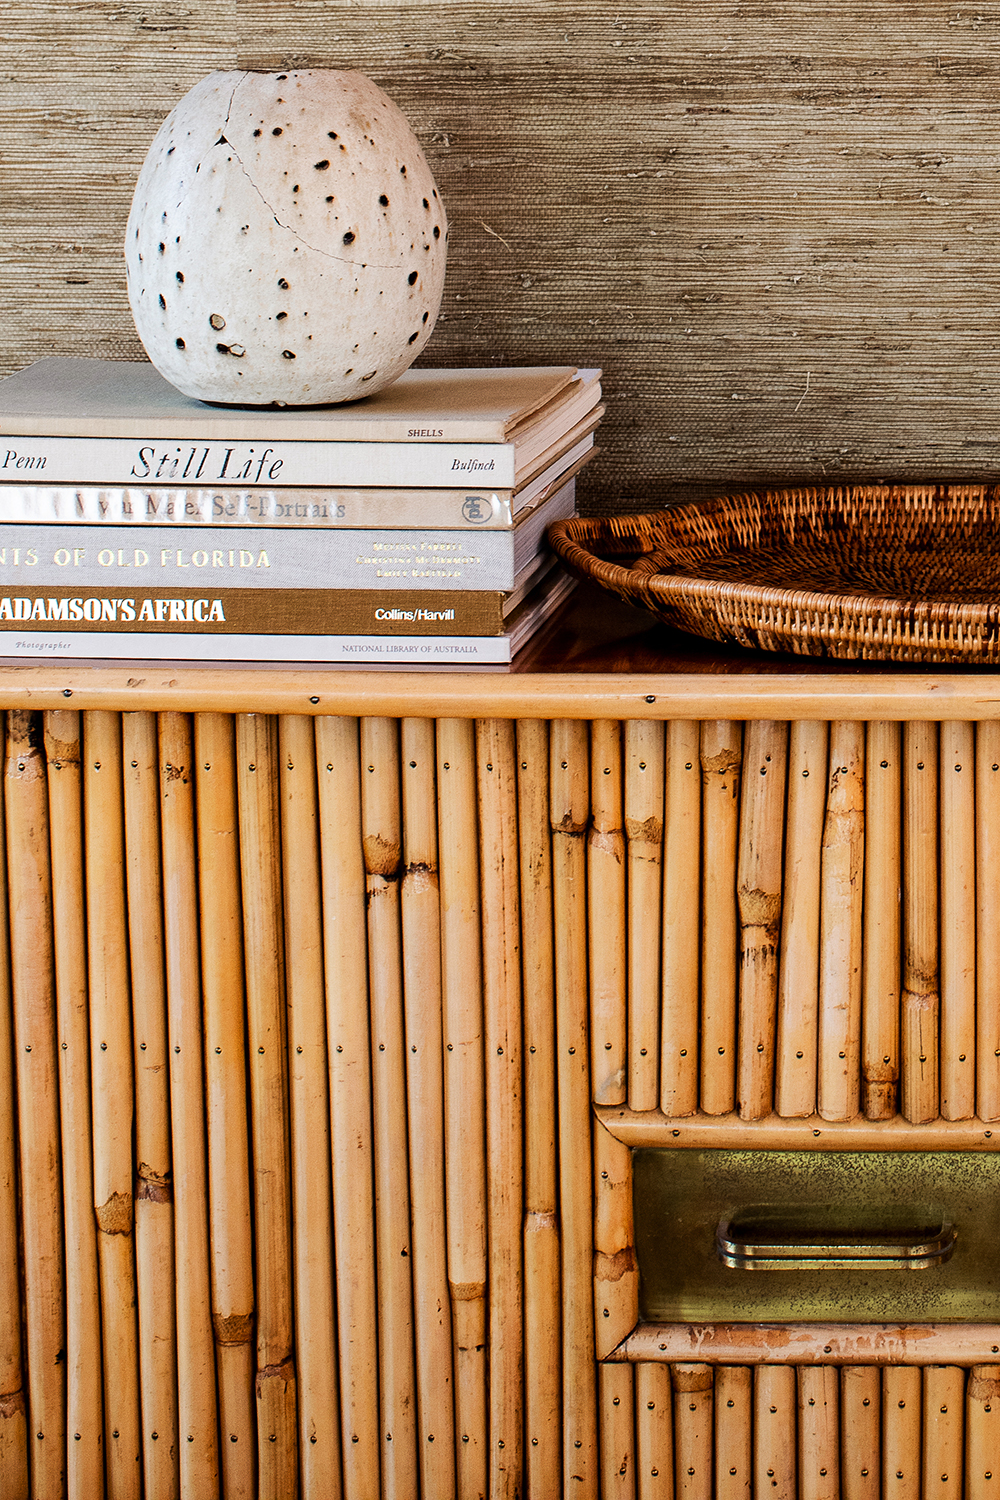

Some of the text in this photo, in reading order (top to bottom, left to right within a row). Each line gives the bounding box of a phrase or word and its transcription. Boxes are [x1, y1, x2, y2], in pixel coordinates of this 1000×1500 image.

[407, 429, 444, 438] SHELLS
[2, 446, 285, 483] Penn Still Life
[451, 458, 496, 473] Bulfinch
[53, 547, 86, 567] OF
[97, 548, 149, 568] OLD
[160, 548, 271, 568] FLORIDA
[0, 597, 226, 622] ADAMSON'S AFRICA
[374, 608, 455, 622] Collins/Harvill
[15, 640, 72, 651] Photographer
[342, 644, 478, 654] NATIONAL LIBRARY OF AUSTRALIA
